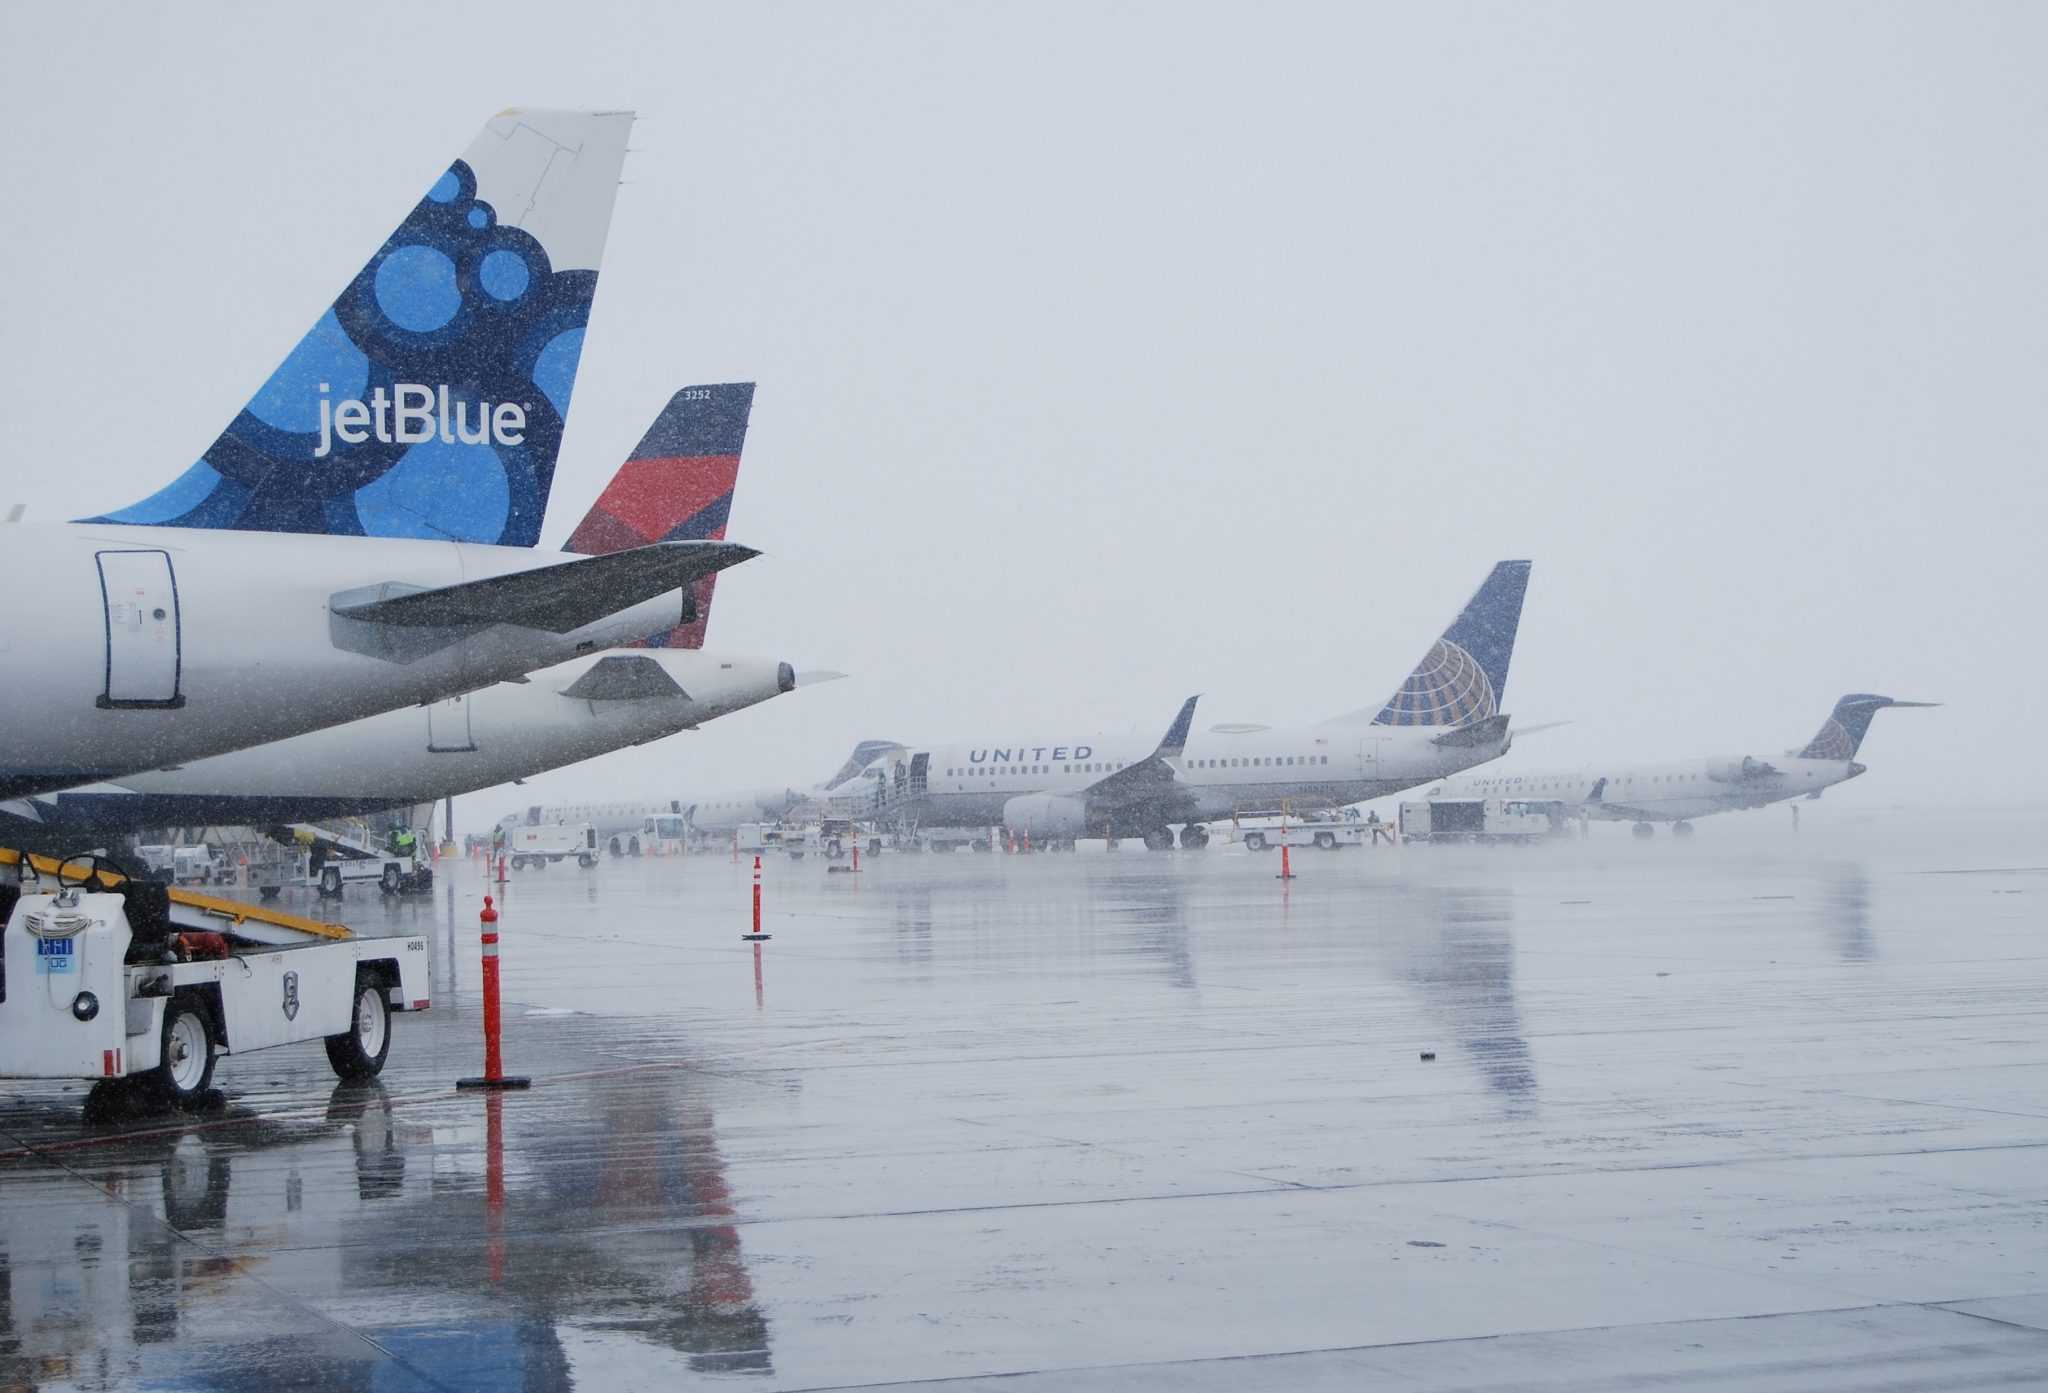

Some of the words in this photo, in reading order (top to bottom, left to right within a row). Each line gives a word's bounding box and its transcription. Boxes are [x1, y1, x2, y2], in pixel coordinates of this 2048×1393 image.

[684, 389, 711, 401] 3252
[314, 382, 527, 458] jetBlue
[969, 746, 1093, 763] UNITED
[1473, 776, 1522, 786] UNITED
